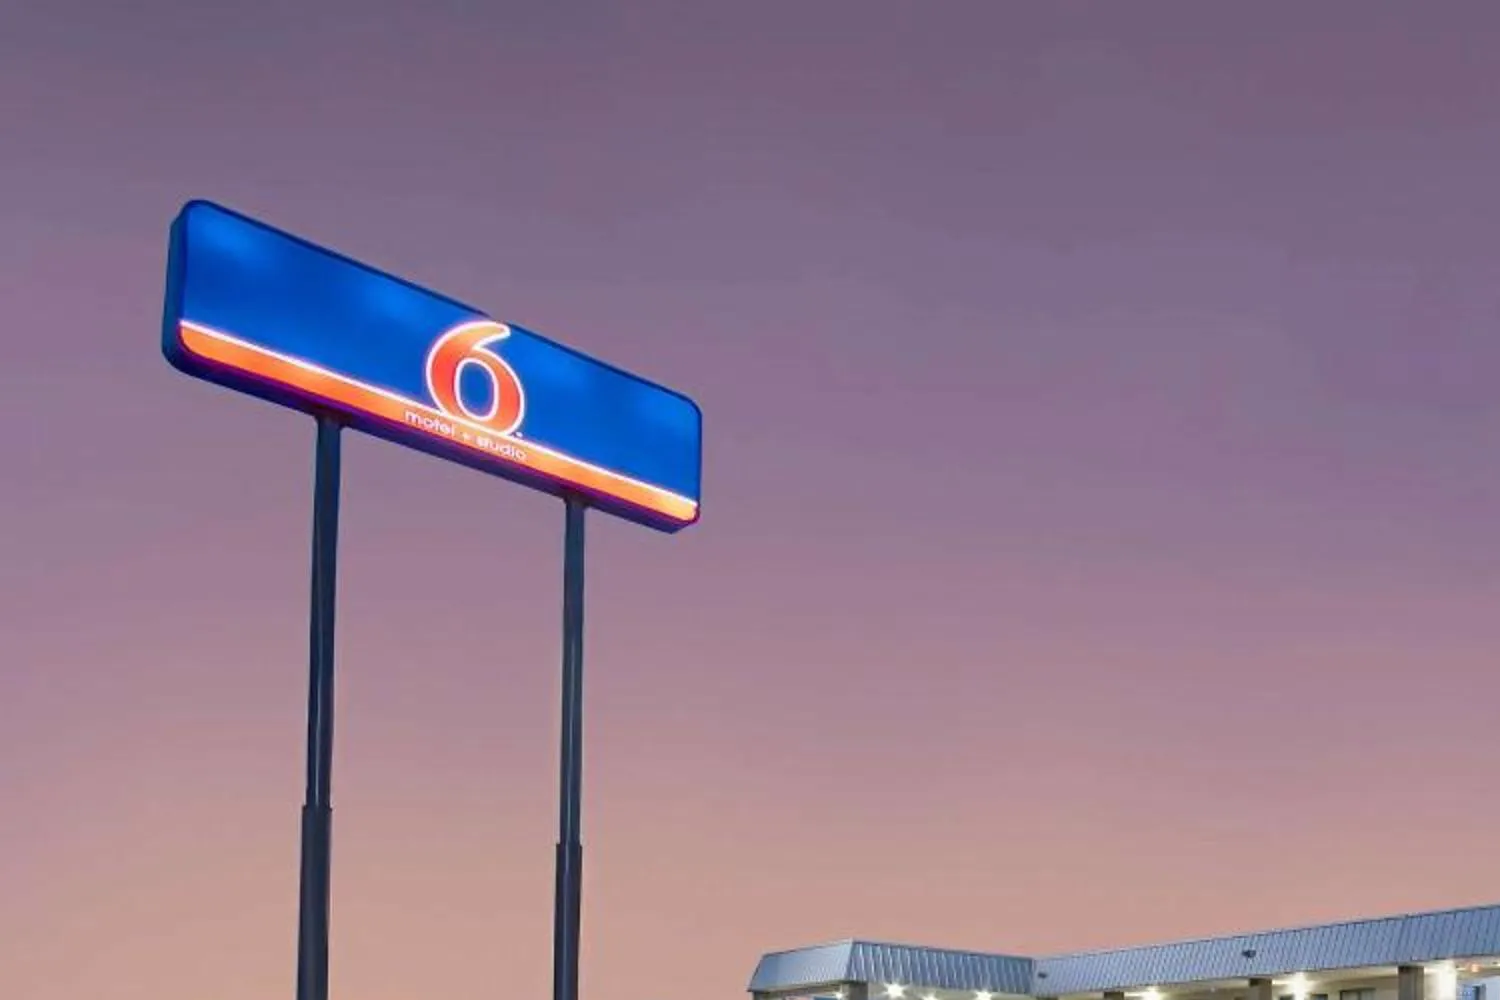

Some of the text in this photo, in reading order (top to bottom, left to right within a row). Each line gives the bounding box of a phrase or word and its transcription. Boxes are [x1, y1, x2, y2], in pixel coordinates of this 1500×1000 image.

[425, 321, 525, 437] 6
[405, 410, 456, 437] motel
[475, 434, 527, 461] studio
